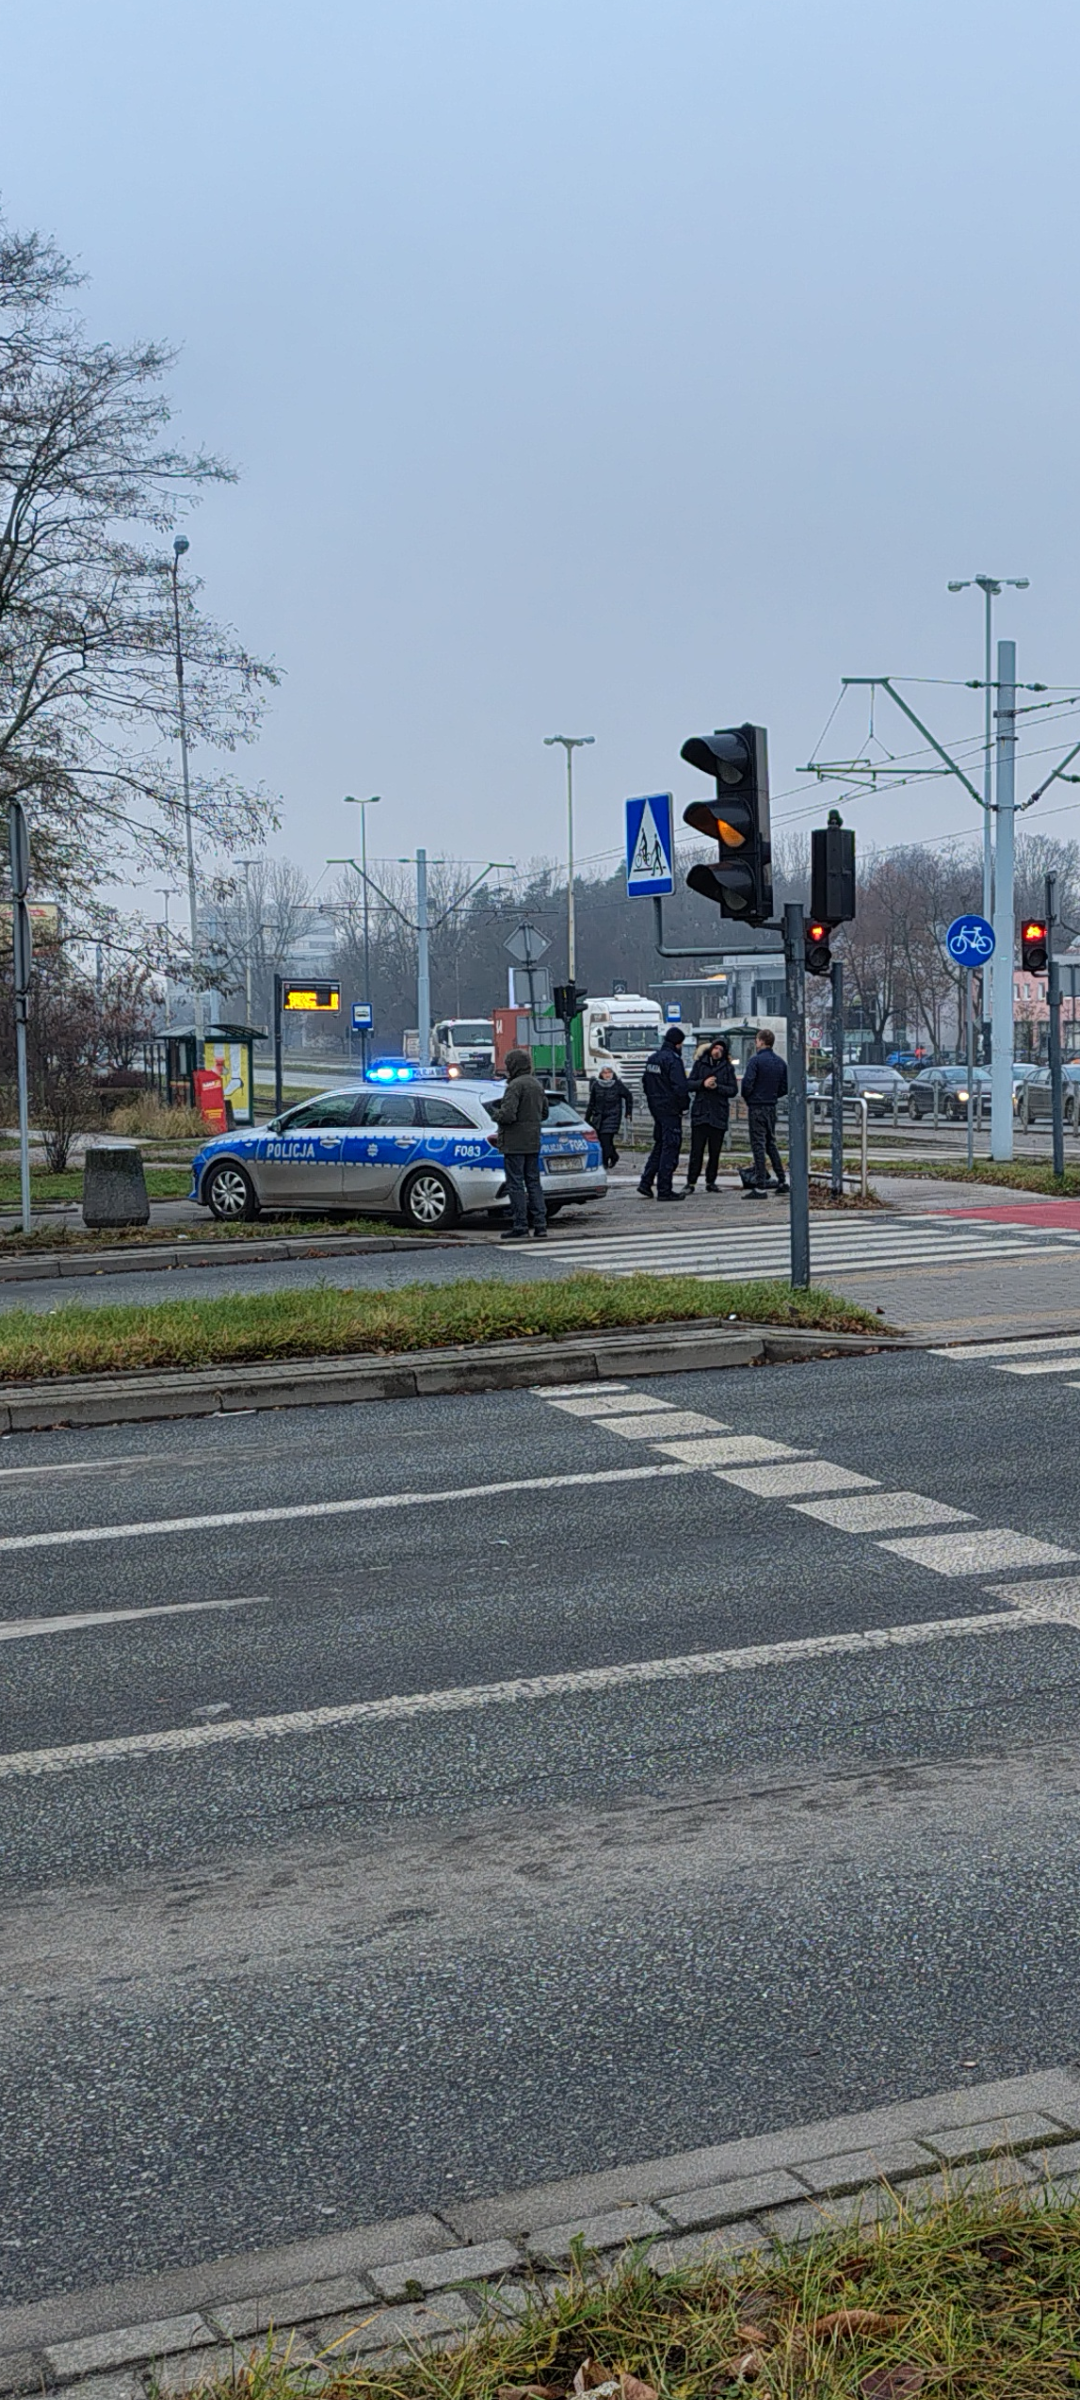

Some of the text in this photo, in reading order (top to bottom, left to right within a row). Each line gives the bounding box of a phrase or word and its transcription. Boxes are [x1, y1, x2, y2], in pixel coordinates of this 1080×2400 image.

[266, 1143, 316, 1158] POLICJA
[454, 1145, 481, 1157] F083
[568, 1139, 589, 1151] F083
